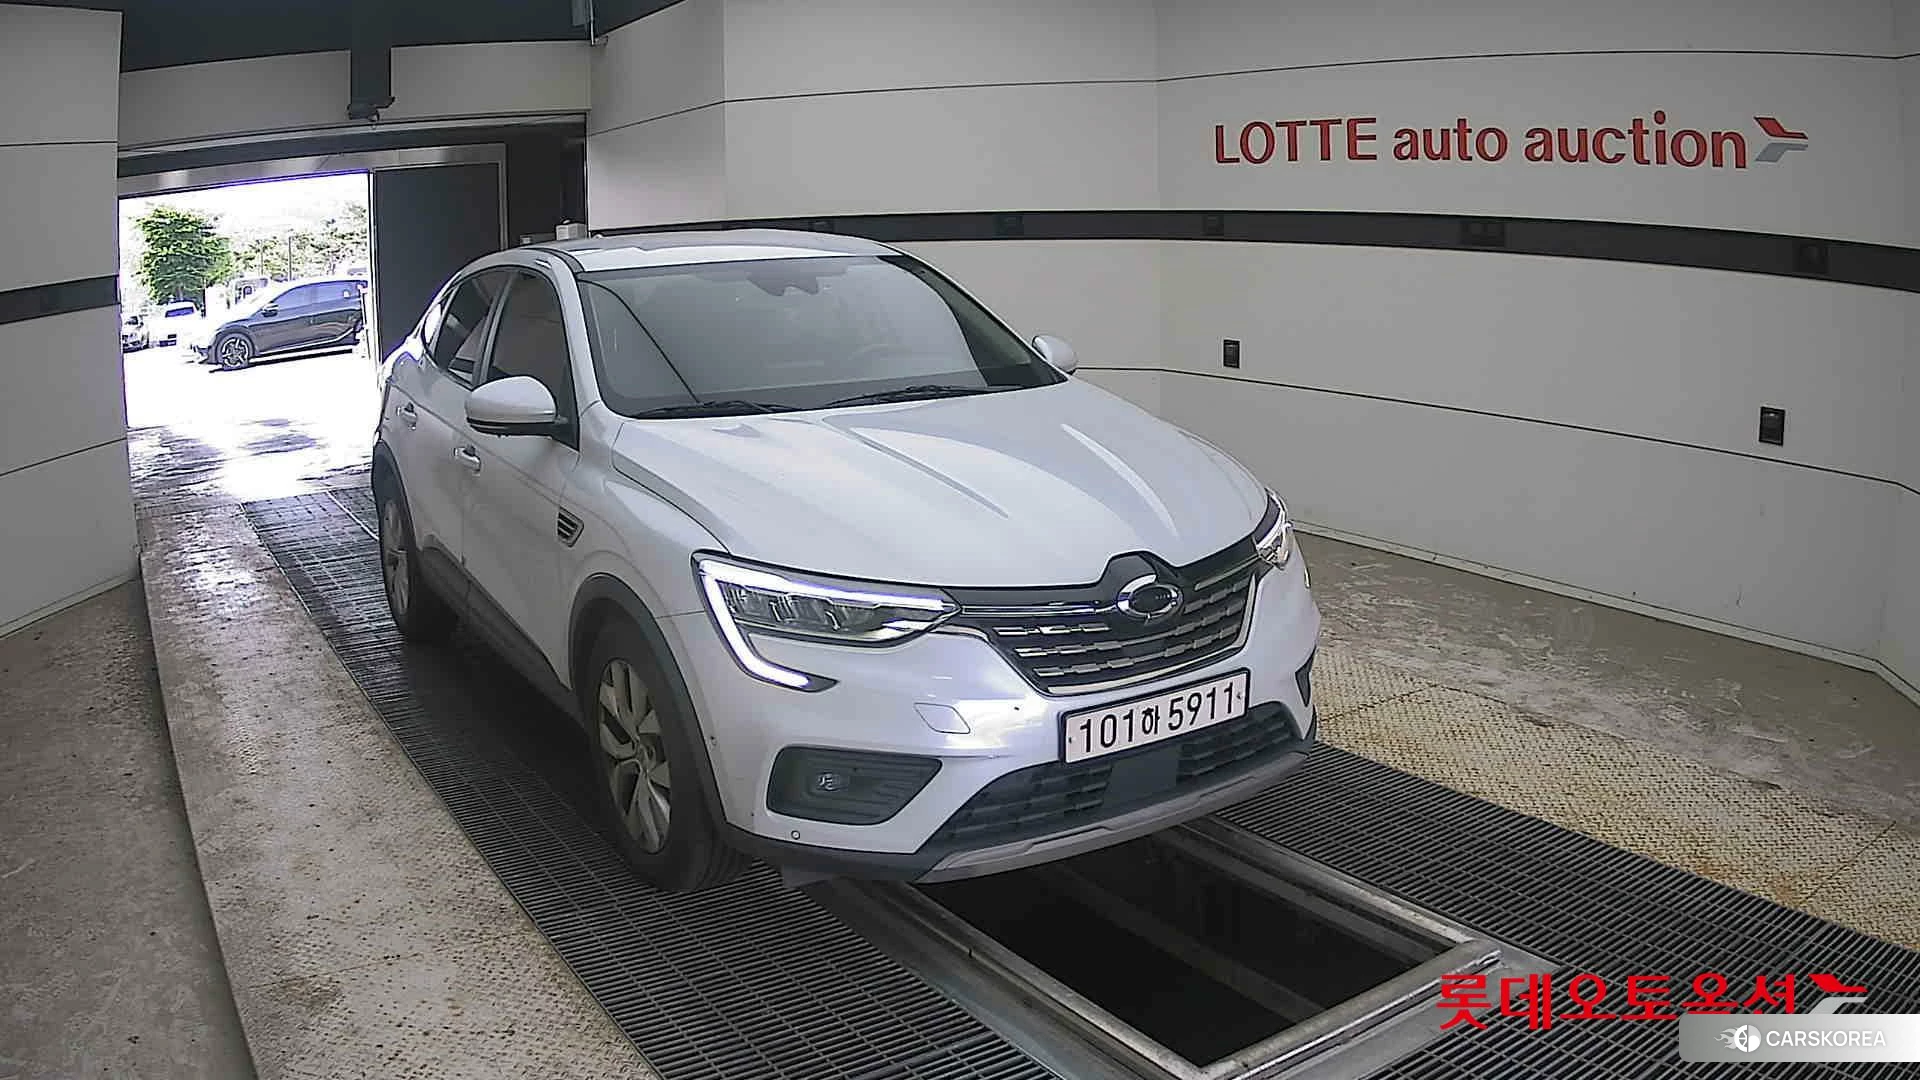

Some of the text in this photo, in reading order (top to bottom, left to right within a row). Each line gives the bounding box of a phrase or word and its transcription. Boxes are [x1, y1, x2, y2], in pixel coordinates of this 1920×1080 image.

[1215, 110, 1747, 168] LOTTE auto auction
